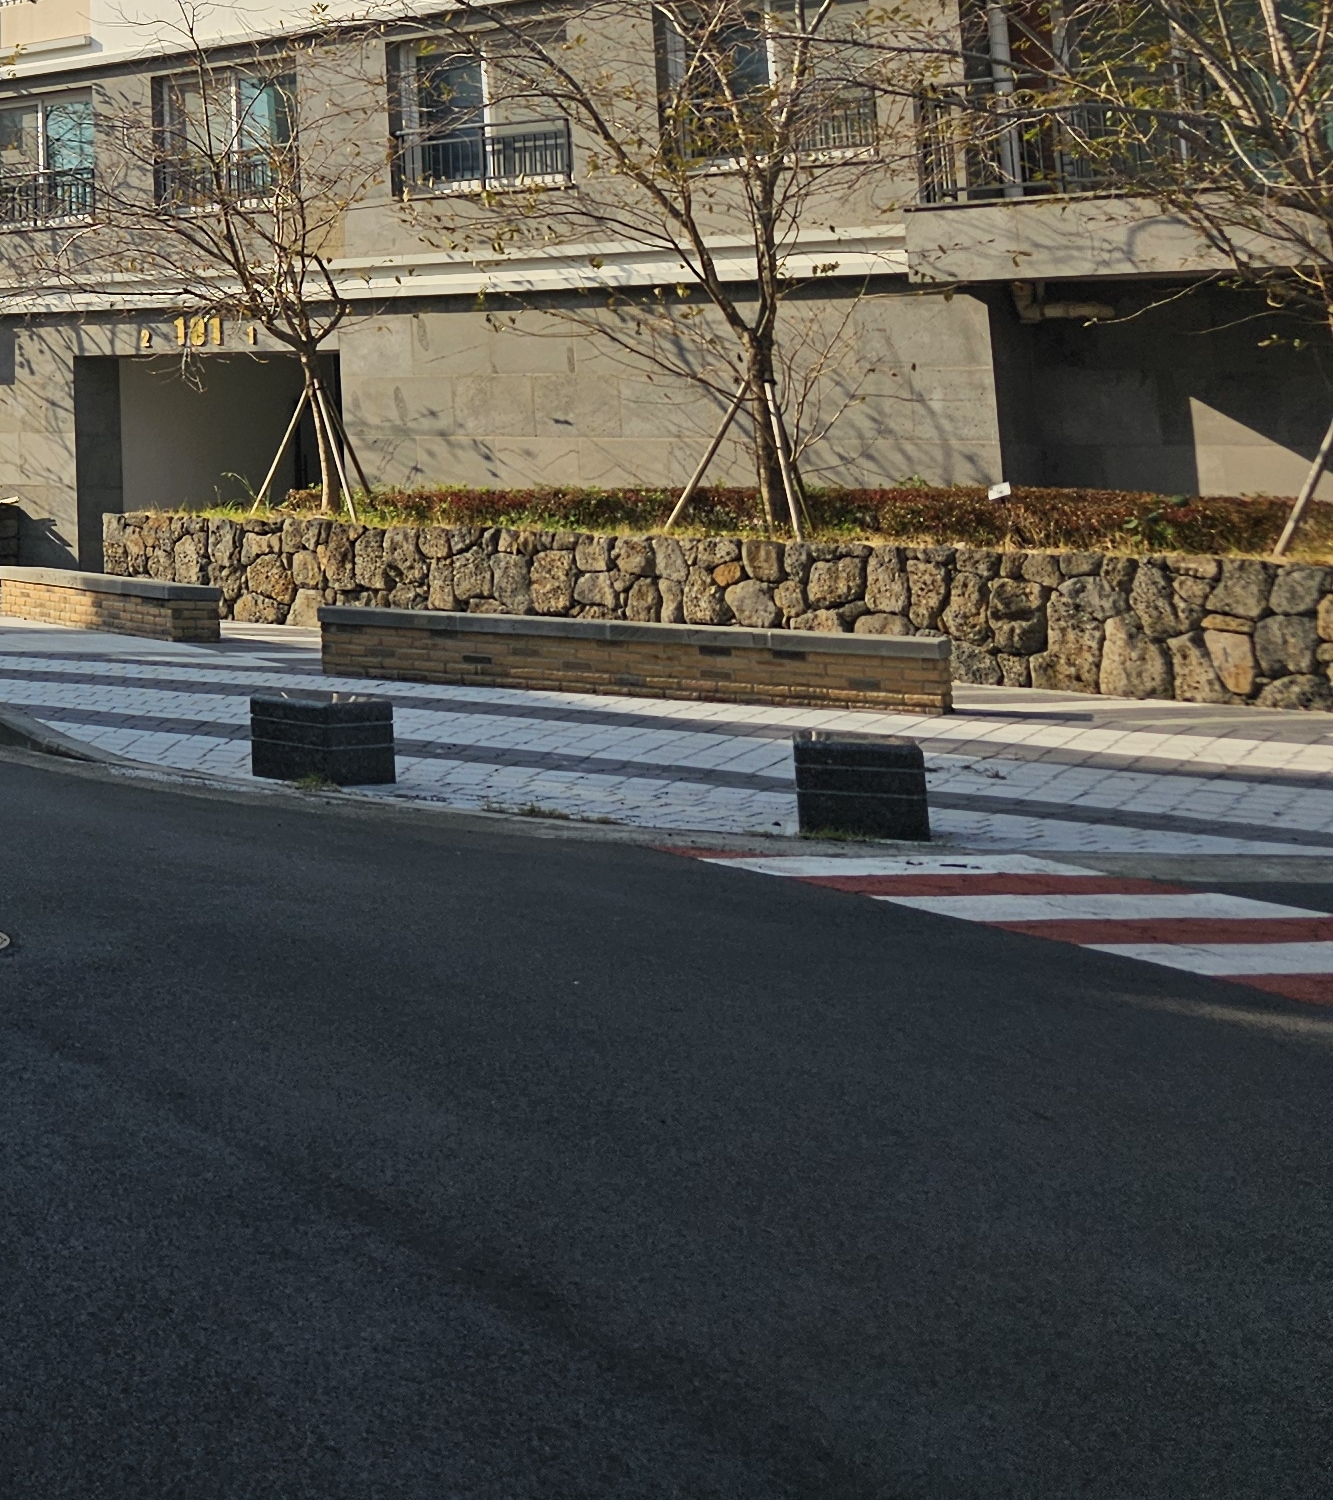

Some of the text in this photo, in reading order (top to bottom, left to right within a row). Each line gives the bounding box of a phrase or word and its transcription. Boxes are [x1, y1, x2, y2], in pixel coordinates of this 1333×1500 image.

[140, 316, 255, 347] 2 101 1
